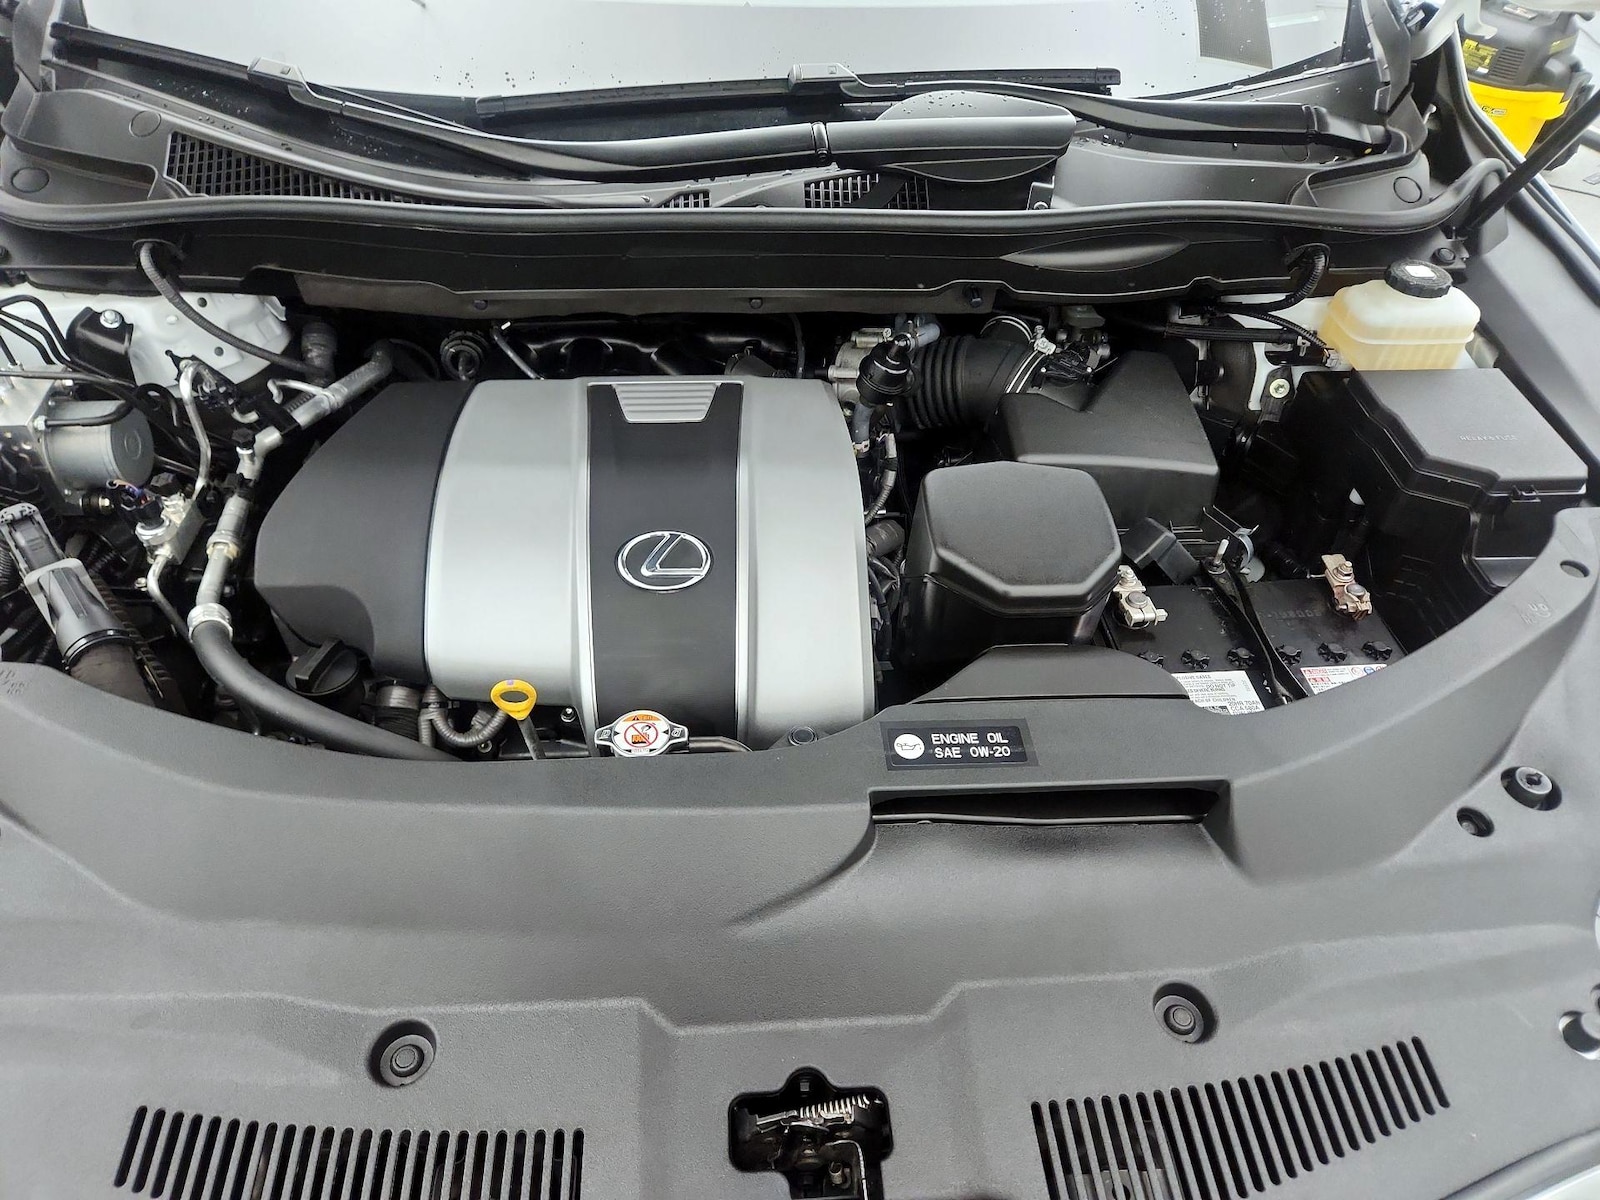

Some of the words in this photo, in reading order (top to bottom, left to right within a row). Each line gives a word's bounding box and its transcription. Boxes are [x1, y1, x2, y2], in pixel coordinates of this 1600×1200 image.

[931, 732, 980, 745] ENGINE
[987, 732, 1009, 744] OIL
[934, 746, 962, 759] SAE
[969, 745, 1011, 758] 0W-20
